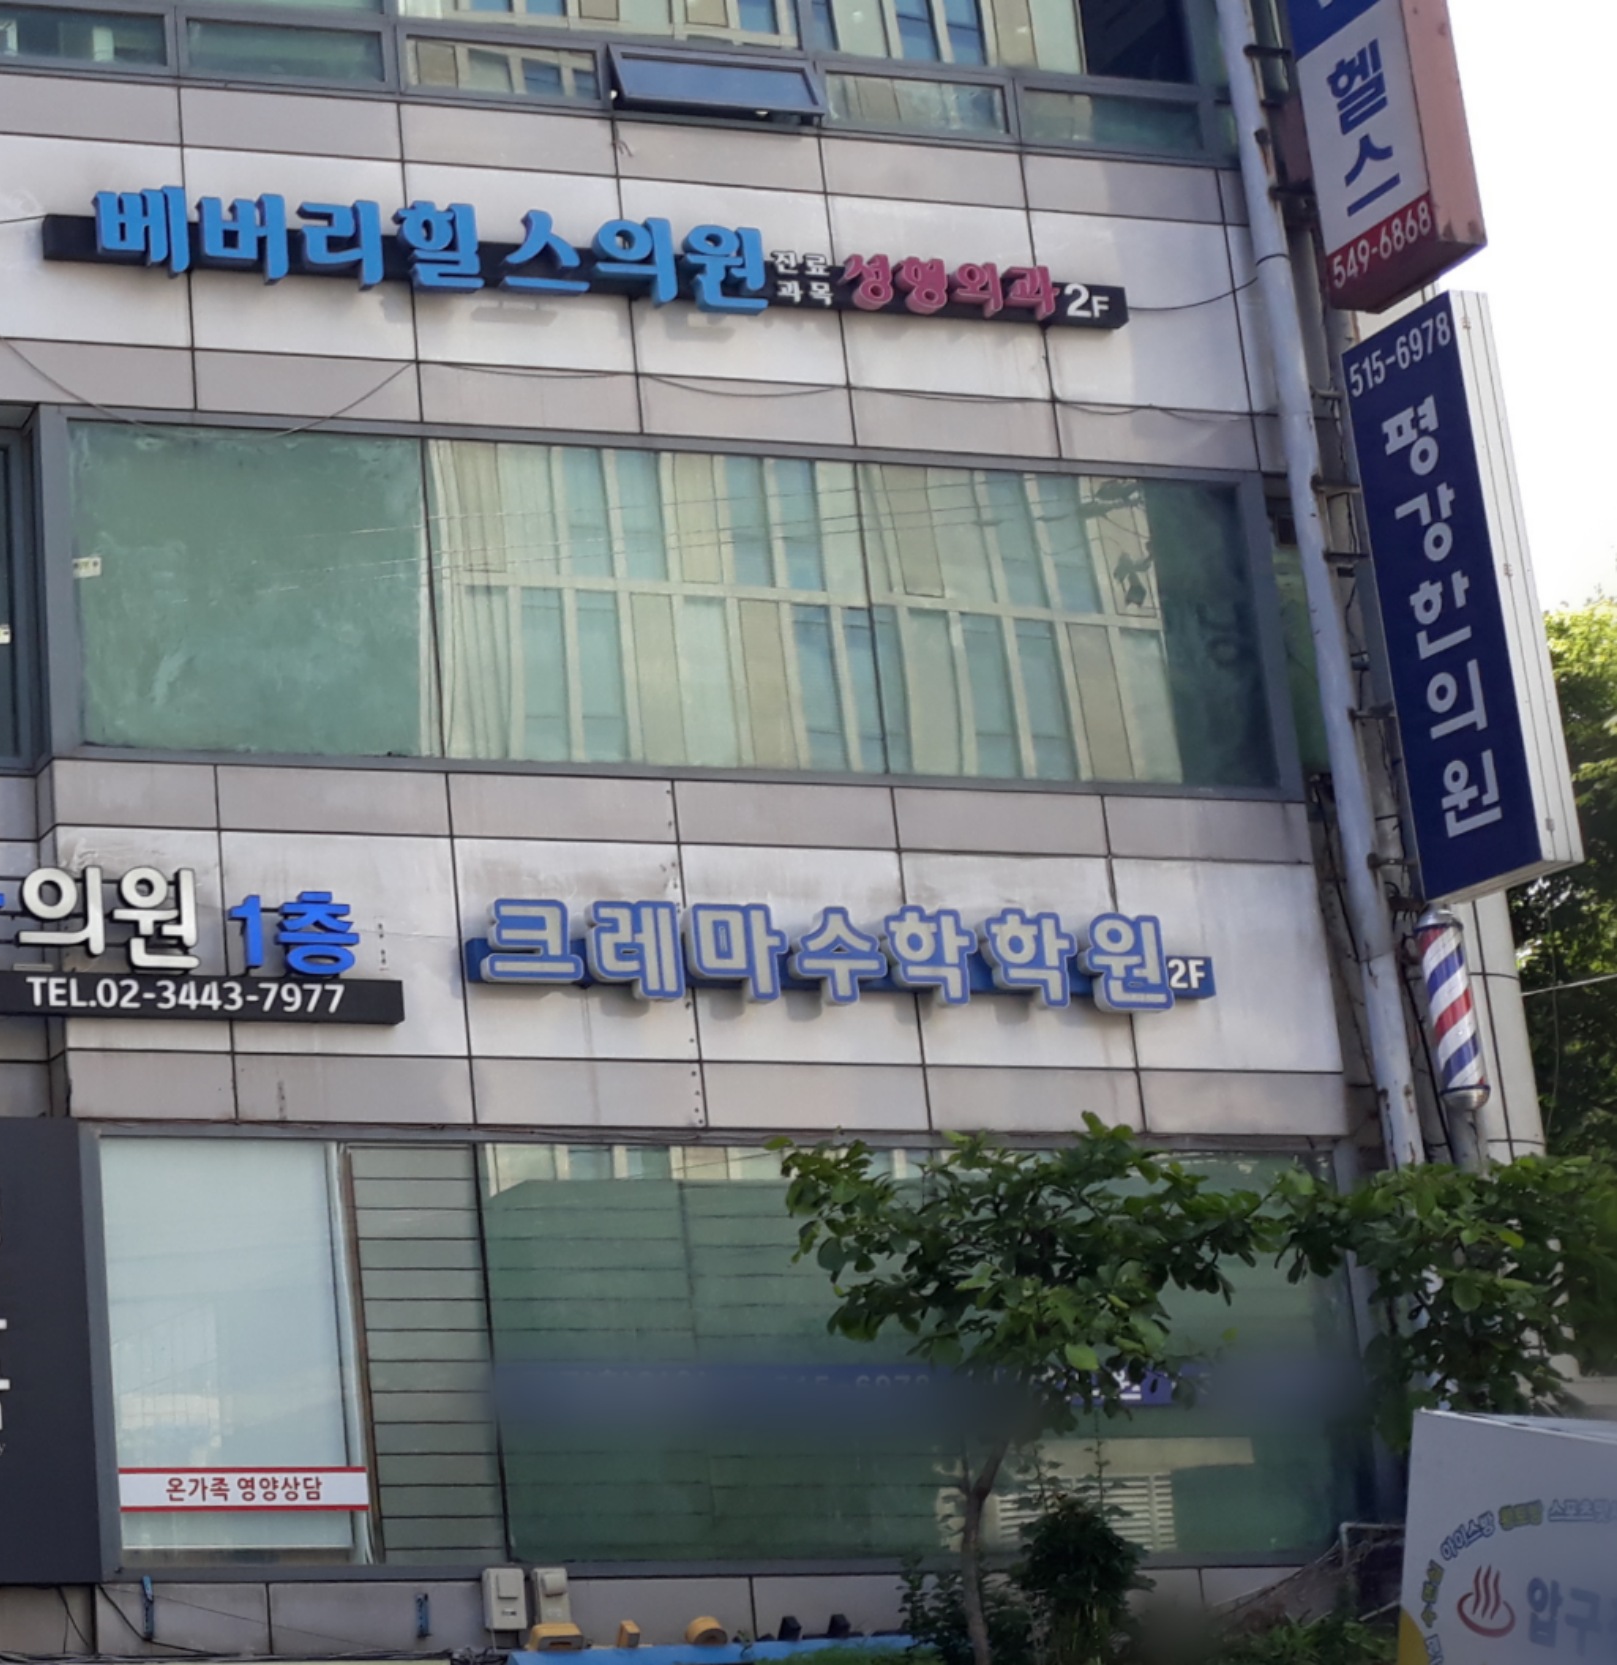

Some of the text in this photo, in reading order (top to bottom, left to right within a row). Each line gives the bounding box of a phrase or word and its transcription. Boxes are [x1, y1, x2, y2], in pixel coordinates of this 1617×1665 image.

[1326, 38, 1401, 217] 헬스
[838, 252, 1061, 321] 성형외과
[1063, 282, 1110, 319] 2F
[1331, 203, 1433, 289] 549-6868
[1349, 310, 1452, 398] 515-6978
[1382, 395, 1503, 838] 평강한의원
[228, 890, 362, 974] 1층
[1167, 953, 1207, 991] 2F
[26, 975, 346, 1014] TEL.02-3443-7977
[165, 1475, 323, 1503] 온가족 영양상담
